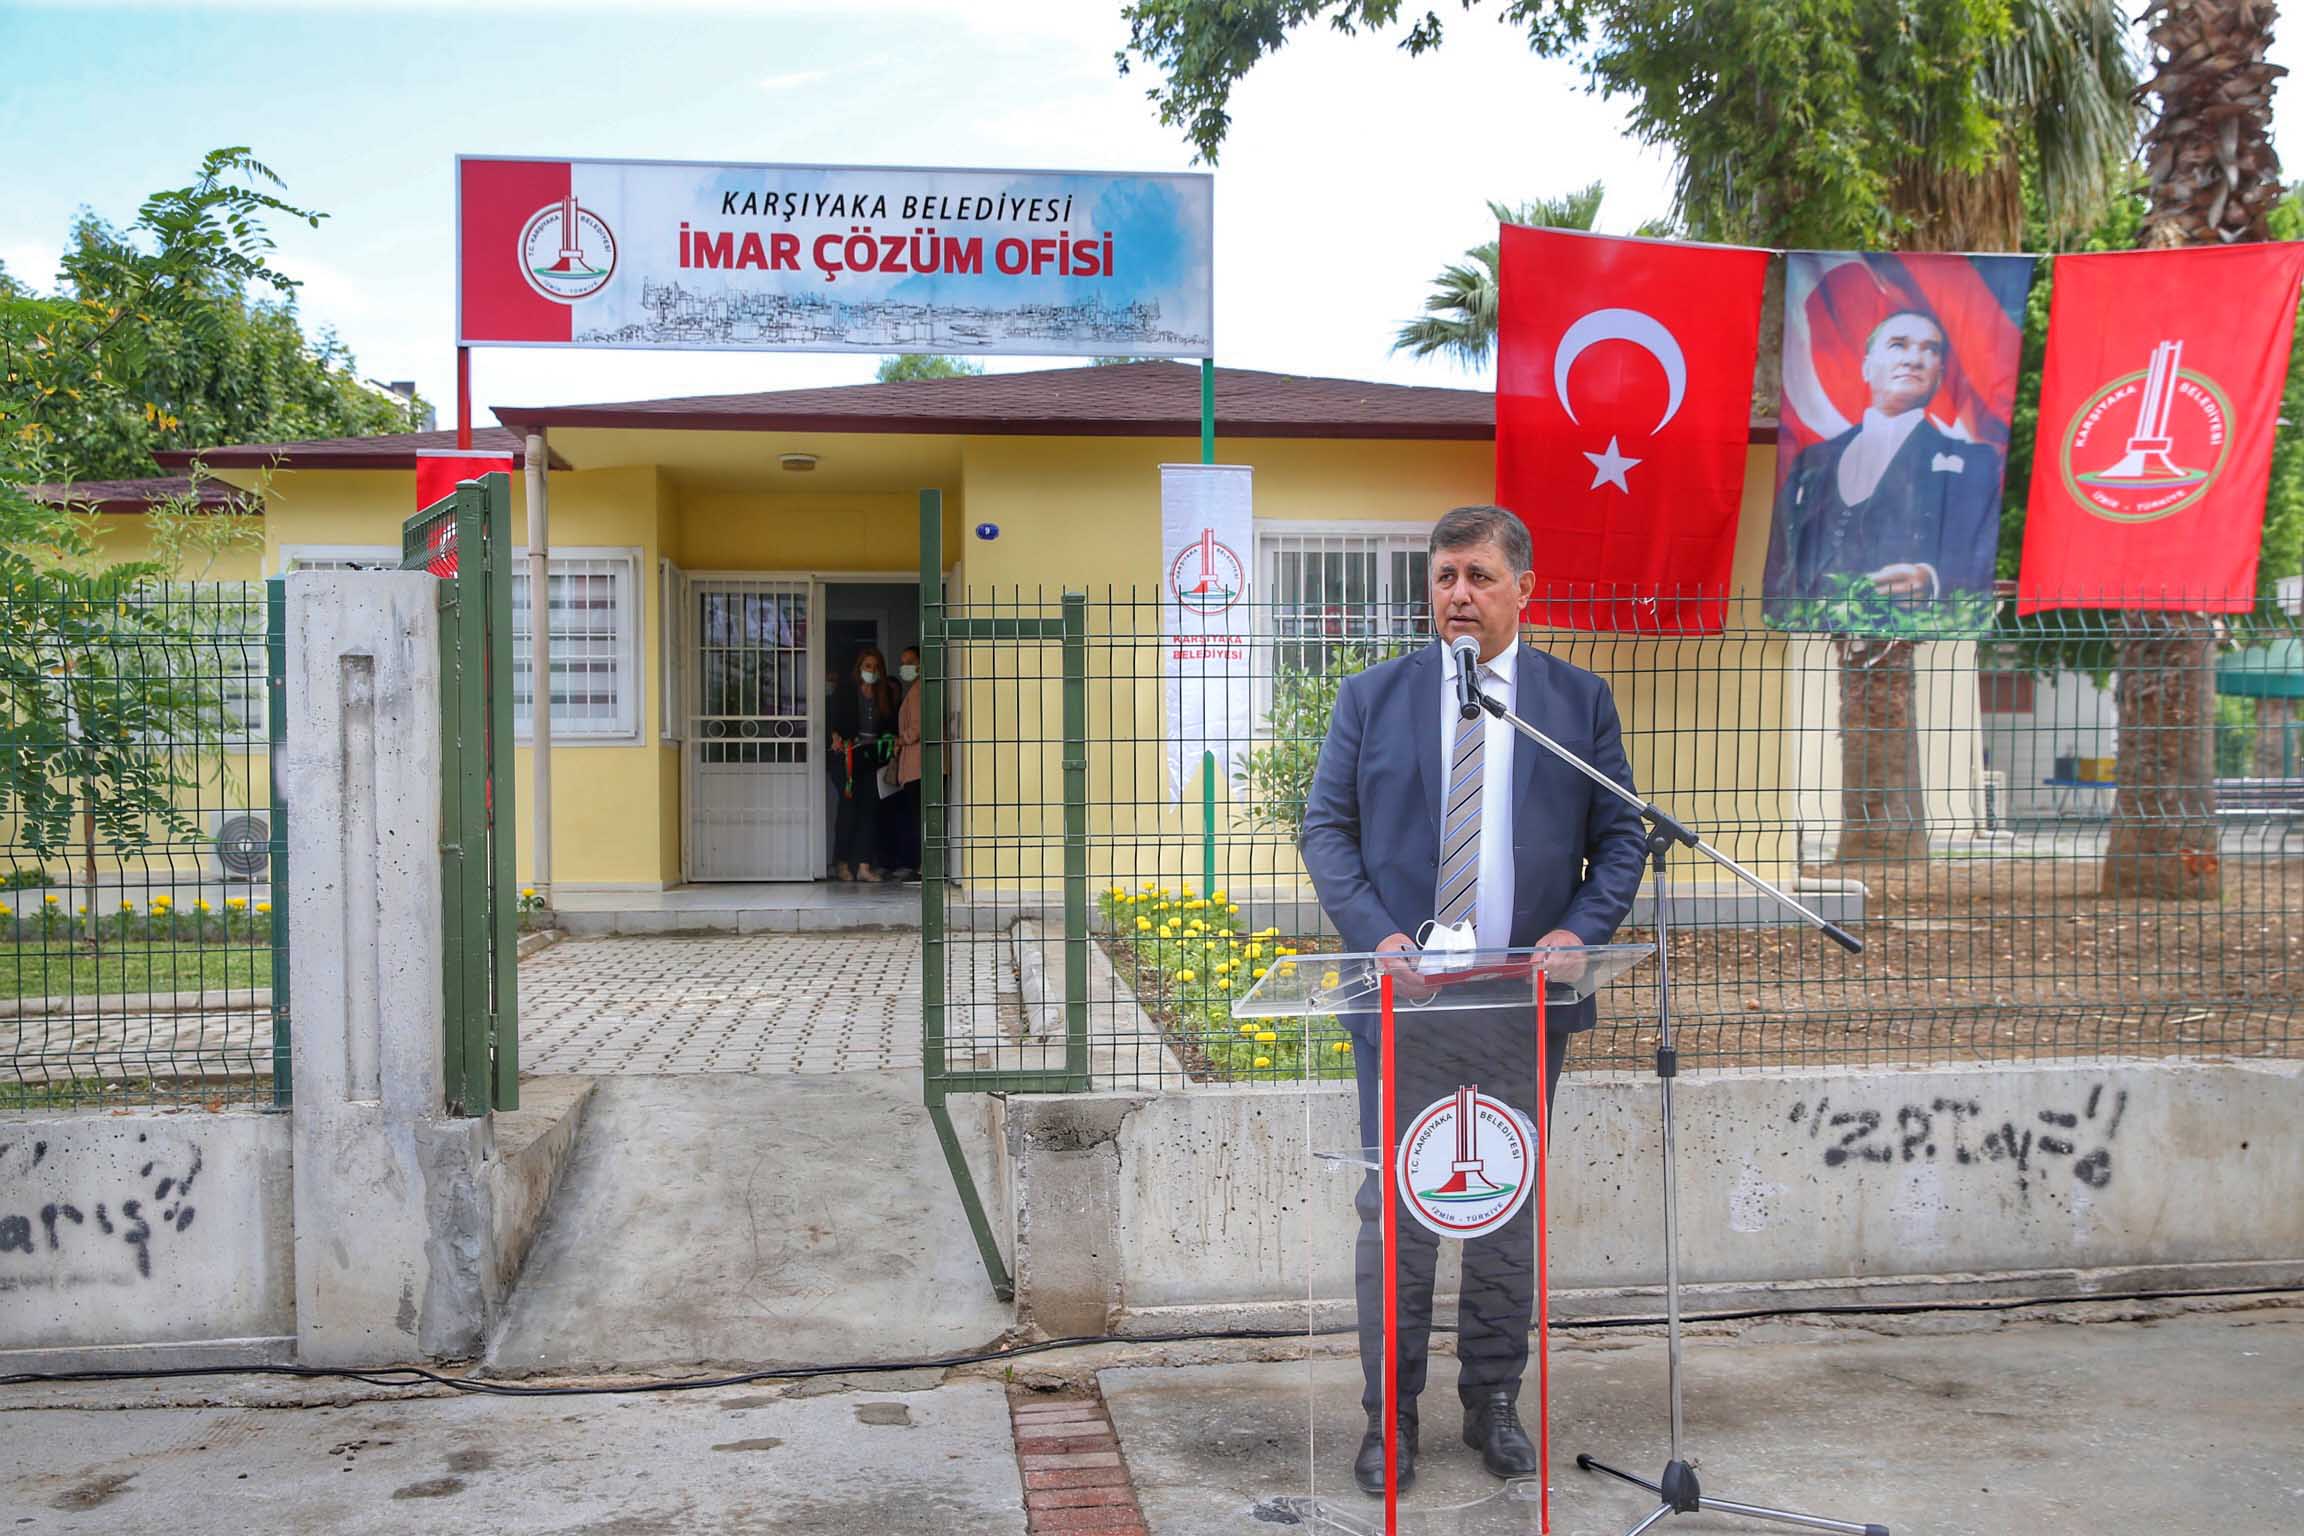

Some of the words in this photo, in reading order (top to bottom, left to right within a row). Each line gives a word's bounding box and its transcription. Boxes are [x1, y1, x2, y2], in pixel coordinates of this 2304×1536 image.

[721, 191, 887, 222] KARŞIYAKA
[902, 192, 1073, 223] BELEDİYESİ
[679, 222, 801, 270] İMAR
[812, 226, 983, 282] ÇÖZÜM
[995, 230, 1114, 277] OFİSİ
[2179, 383, 2222, 445] BELEDİYESİ
[1173, 648, 1242, 660] BELEDİYESİ
[1480, 1112, 1520, 1159] BELEDİYESİ
[1467, 1202, 1503, 1221] TÜRKİYE
